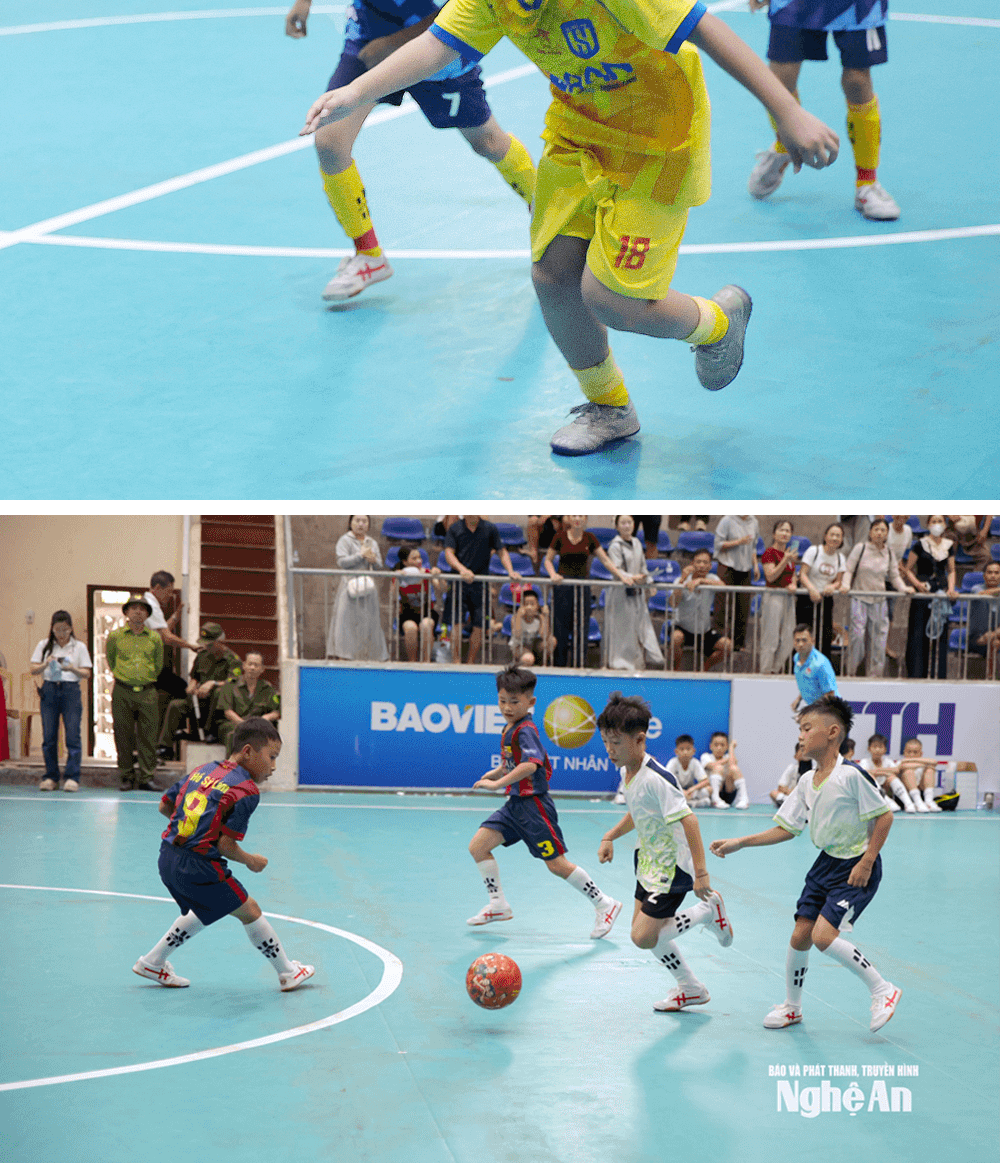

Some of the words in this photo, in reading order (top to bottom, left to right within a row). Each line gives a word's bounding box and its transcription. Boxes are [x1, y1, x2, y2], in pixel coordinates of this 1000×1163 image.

[442, 92, 461, 117] 7
[615, 235, 651, 270] 18
[370, 701, 534, 734] BAOVIE
[563, 753, 609, 772] NHÂN
[536, 840, 555, 857] 3
